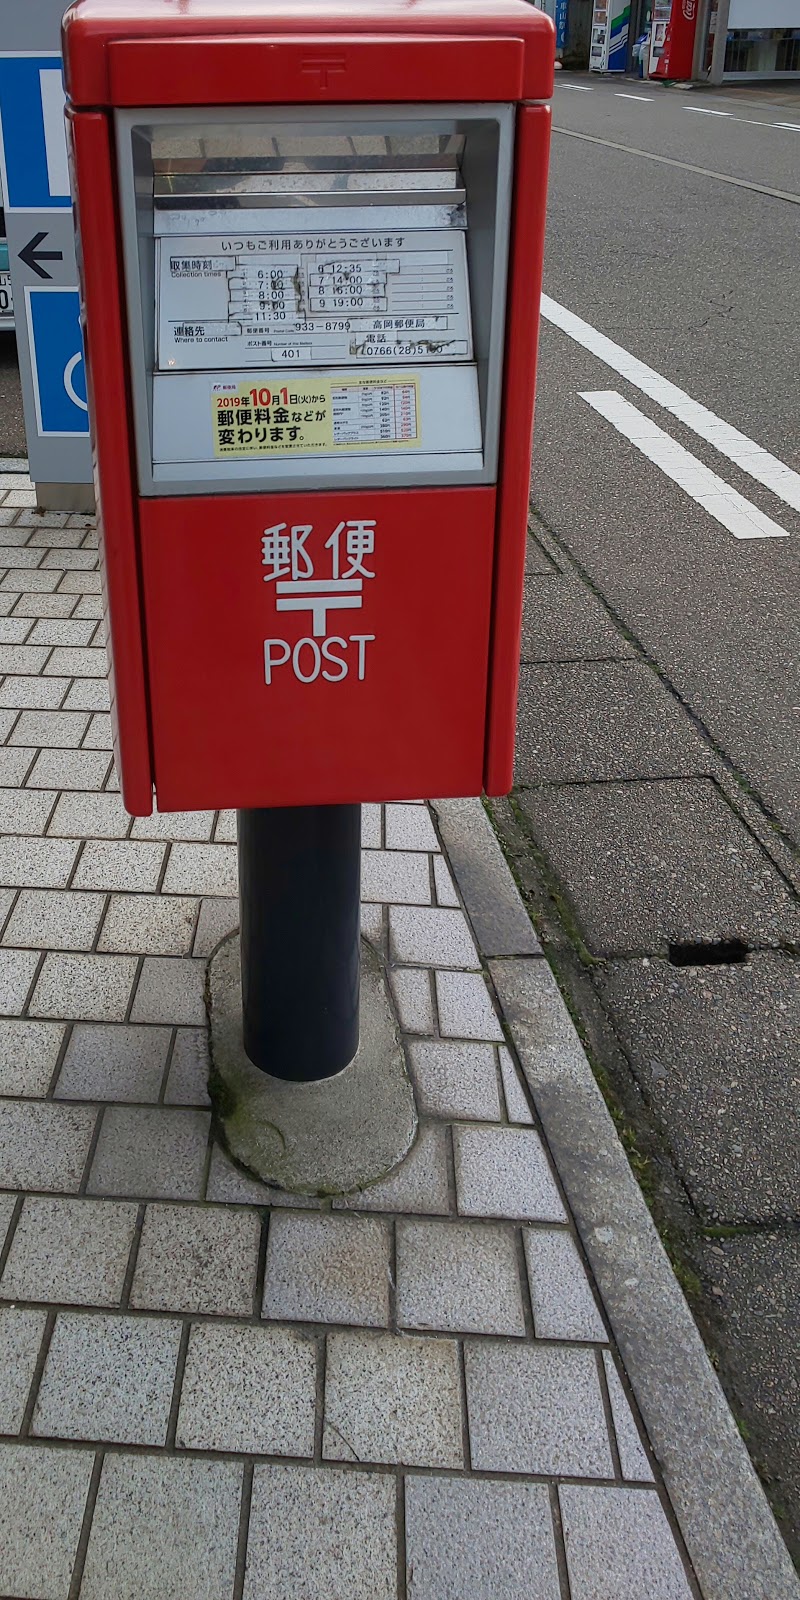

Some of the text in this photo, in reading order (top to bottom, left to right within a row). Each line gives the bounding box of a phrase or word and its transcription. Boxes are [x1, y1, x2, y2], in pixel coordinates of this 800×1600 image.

[221, 237, 405, 251] いつもご利用ありがとうございます
[171, 259, 213, 271] 収集時刻
[317, 264, 362, 273] 6 12:35
[257, 269, 284, 279] 6:00
[257, 280, 284, 290] 7:00
[318, 275, 363, 285] 7 14:00
[258, 290, 284, 300] 8:00
[318, 286, 363, 295] 8 16:00
[259, 300, 285, 310] 9:00
[319, 297, 363, 308] 9 19:00
[255, 311, 286, 321] 11:30
[373, 318, 425, 330] 高岡郵便局
[173, 325, 205, 337] 連絡先
[366, 333, 387, 343] 電話
[281, 349, 300, 358] 401
[217, 407, 327, 427] 郵便料金などが
[218, 426, 304, 446] 変わります。
[261, 520, 377, 582] 郵便
[263, 634, 376, 685] POST
